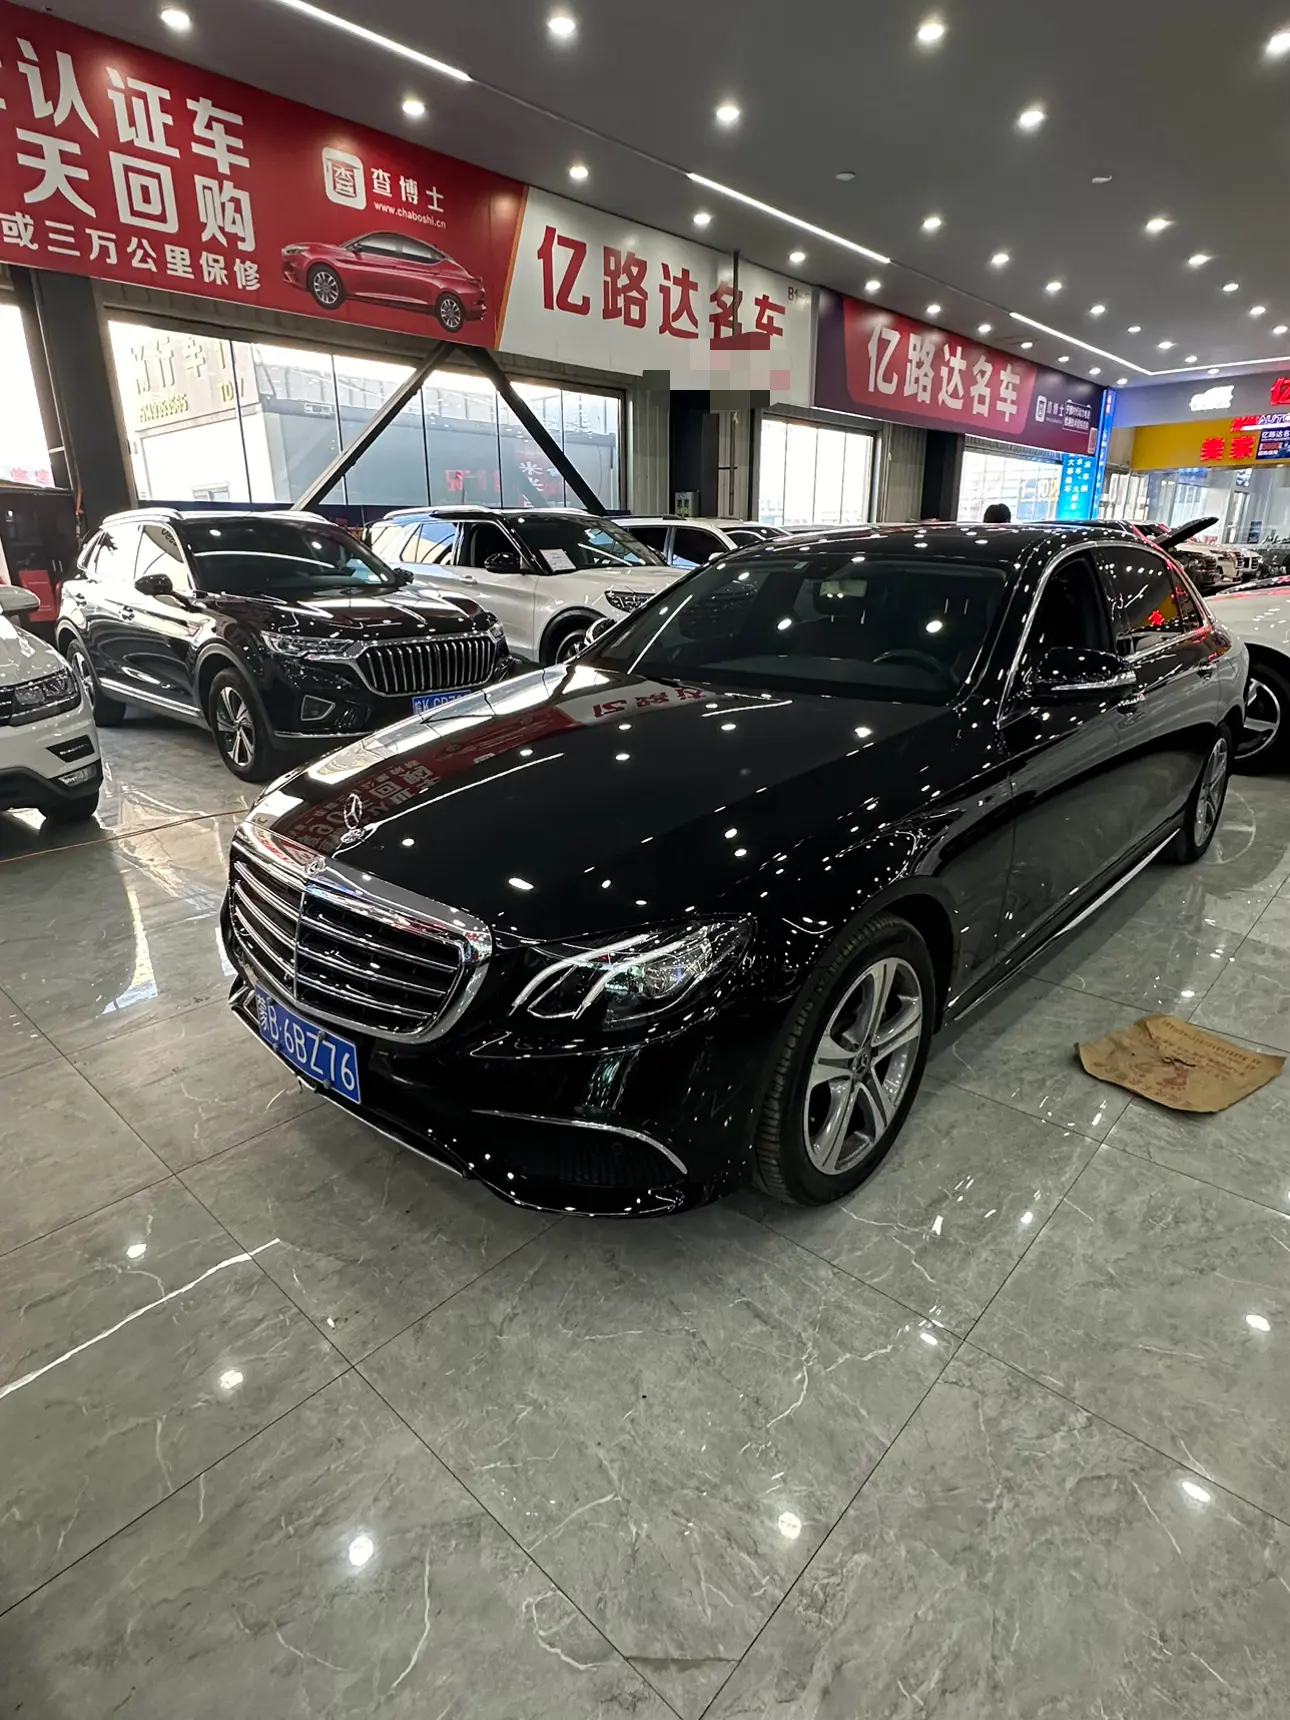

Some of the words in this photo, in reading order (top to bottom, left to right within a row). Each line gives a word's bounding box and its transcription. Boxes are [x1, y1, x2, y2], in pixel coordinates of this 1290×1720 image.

[0, 37, 250, 175] 认证车
[16, 127, 257, 252] 天回购
[371, 167, 444, 213] 查博士
[373, 201, 447, 229] www.chaboshi.cn
[0, 211, 261, 292] 或三万公里保修
[537, 225, 786, 340] 亿路达名车
[867, 323, 1021, 423] 亿路达名车
